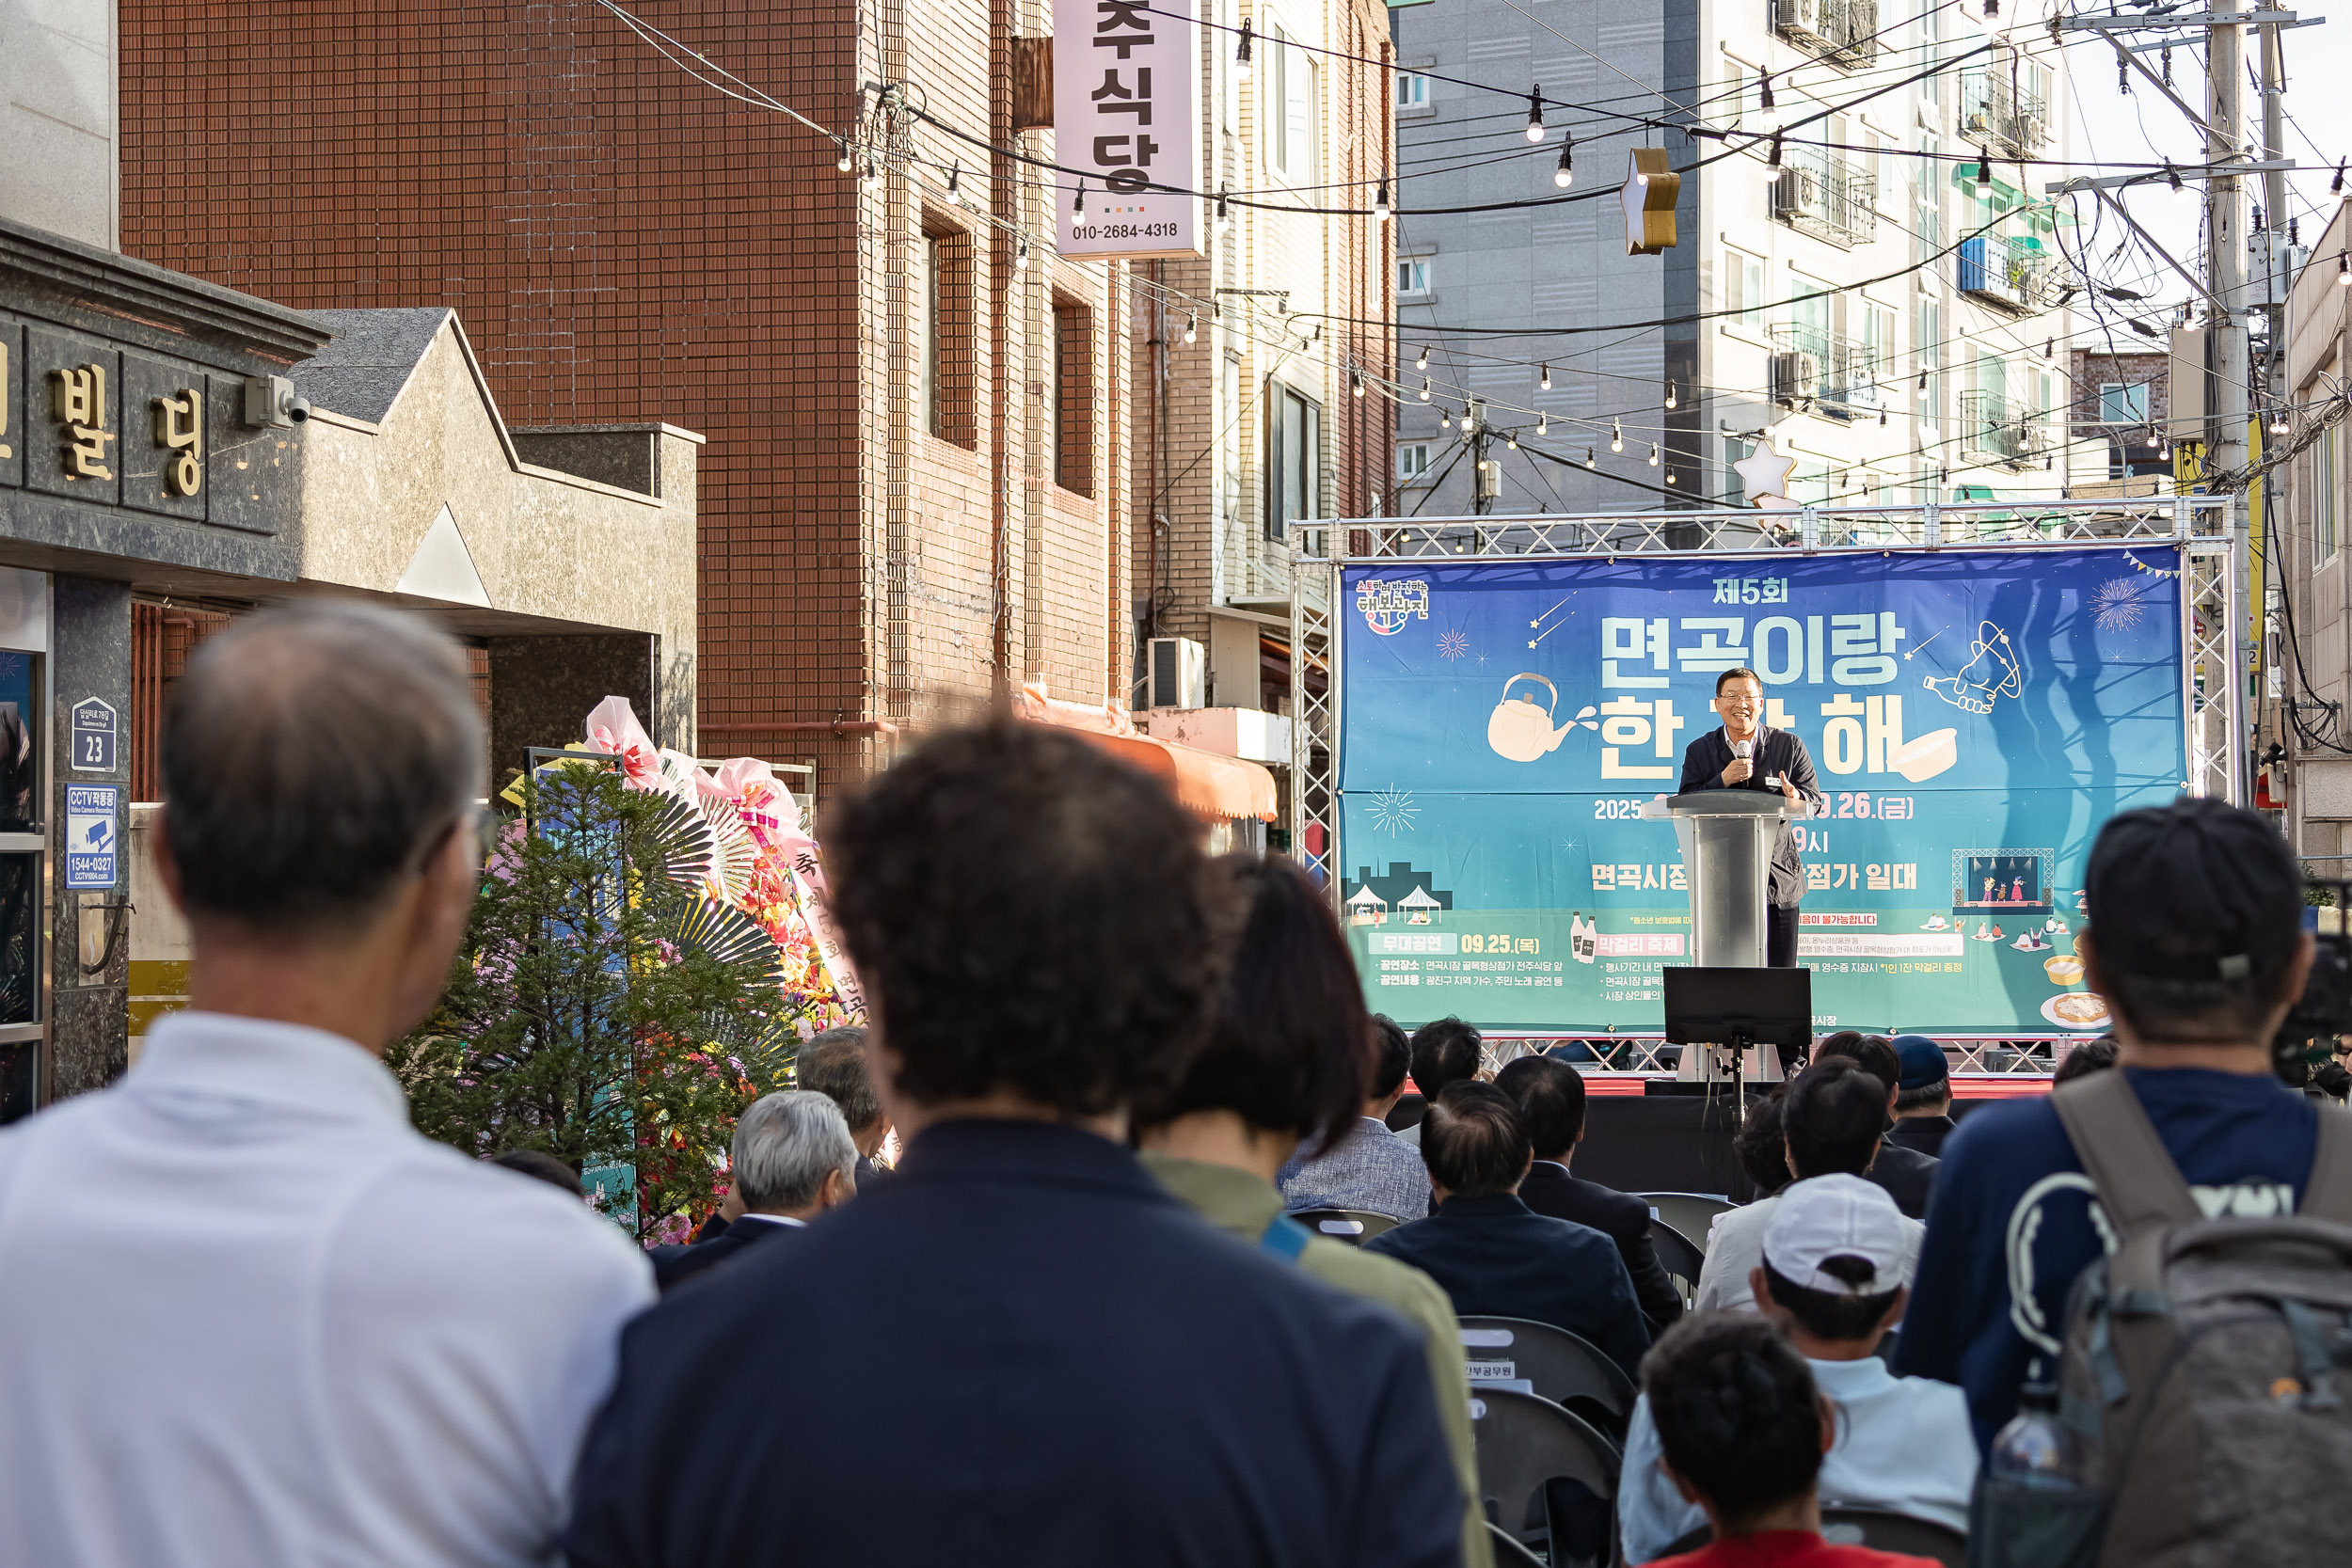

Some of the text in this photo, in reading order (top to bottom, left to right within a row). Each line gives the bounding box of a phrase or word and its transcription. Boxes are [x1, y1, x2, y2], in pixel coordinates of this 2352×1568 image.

[1073, 223, 1178, 241] 010-2684-4318
[1357, 581, 1428, 596] 소통하며 발전하는
[1712, 577, 1788, 605] 제5회
[1358, 594, 1427, 625] 행복광진
[1601, 611, 1906, 689] 면곡이랑
[79, 708, 99, 720] 답십리로
[1600, 693, 1902, 780] 한 해
[86, 735, 103, 763] 23
[70, 791, 114, 806] CCTV작동중
[71, 856, 112, 872] 1544-0327
[794, 852, 819, 878] 축
[1804, 863, 1859, 891] 점가
[1866, 863, 1917, 891] 일대
[1822, 914, 1876, 925] 불가능합니다
[1383, 934, 1540, 955] 무대공연 09.25.(목)
[1598, 936, 1677, 954] 막걸리 축제
[1798, 945, 1813, 954] 발행
[1836, 945, 1862, 954] 면곡시장
[1380, 959, 1564, 972] 공연장소 면곡시장 골목형상점가 전주식당 앞
[1605, 962, 1642, 973] 행사기간
[1643, 962, 1651, 973] 내
[1821, 962, 1849, 973] 영수증
[1851, 962, 1878, 973] 지참시
[1899, 962, 1913, 973] 1잔
[1914, 962, 1942, 973] 막걸리
[1943, 962, 1963, 973] 증정
[1380, 974, 1564, 987] 공연내용 광진구 지역 가수, 주민 노래 공연 등
[1605, 976, 1642, 987] 면곡시장
[1605, 990, 1661, 1002] 시장 상인들의
